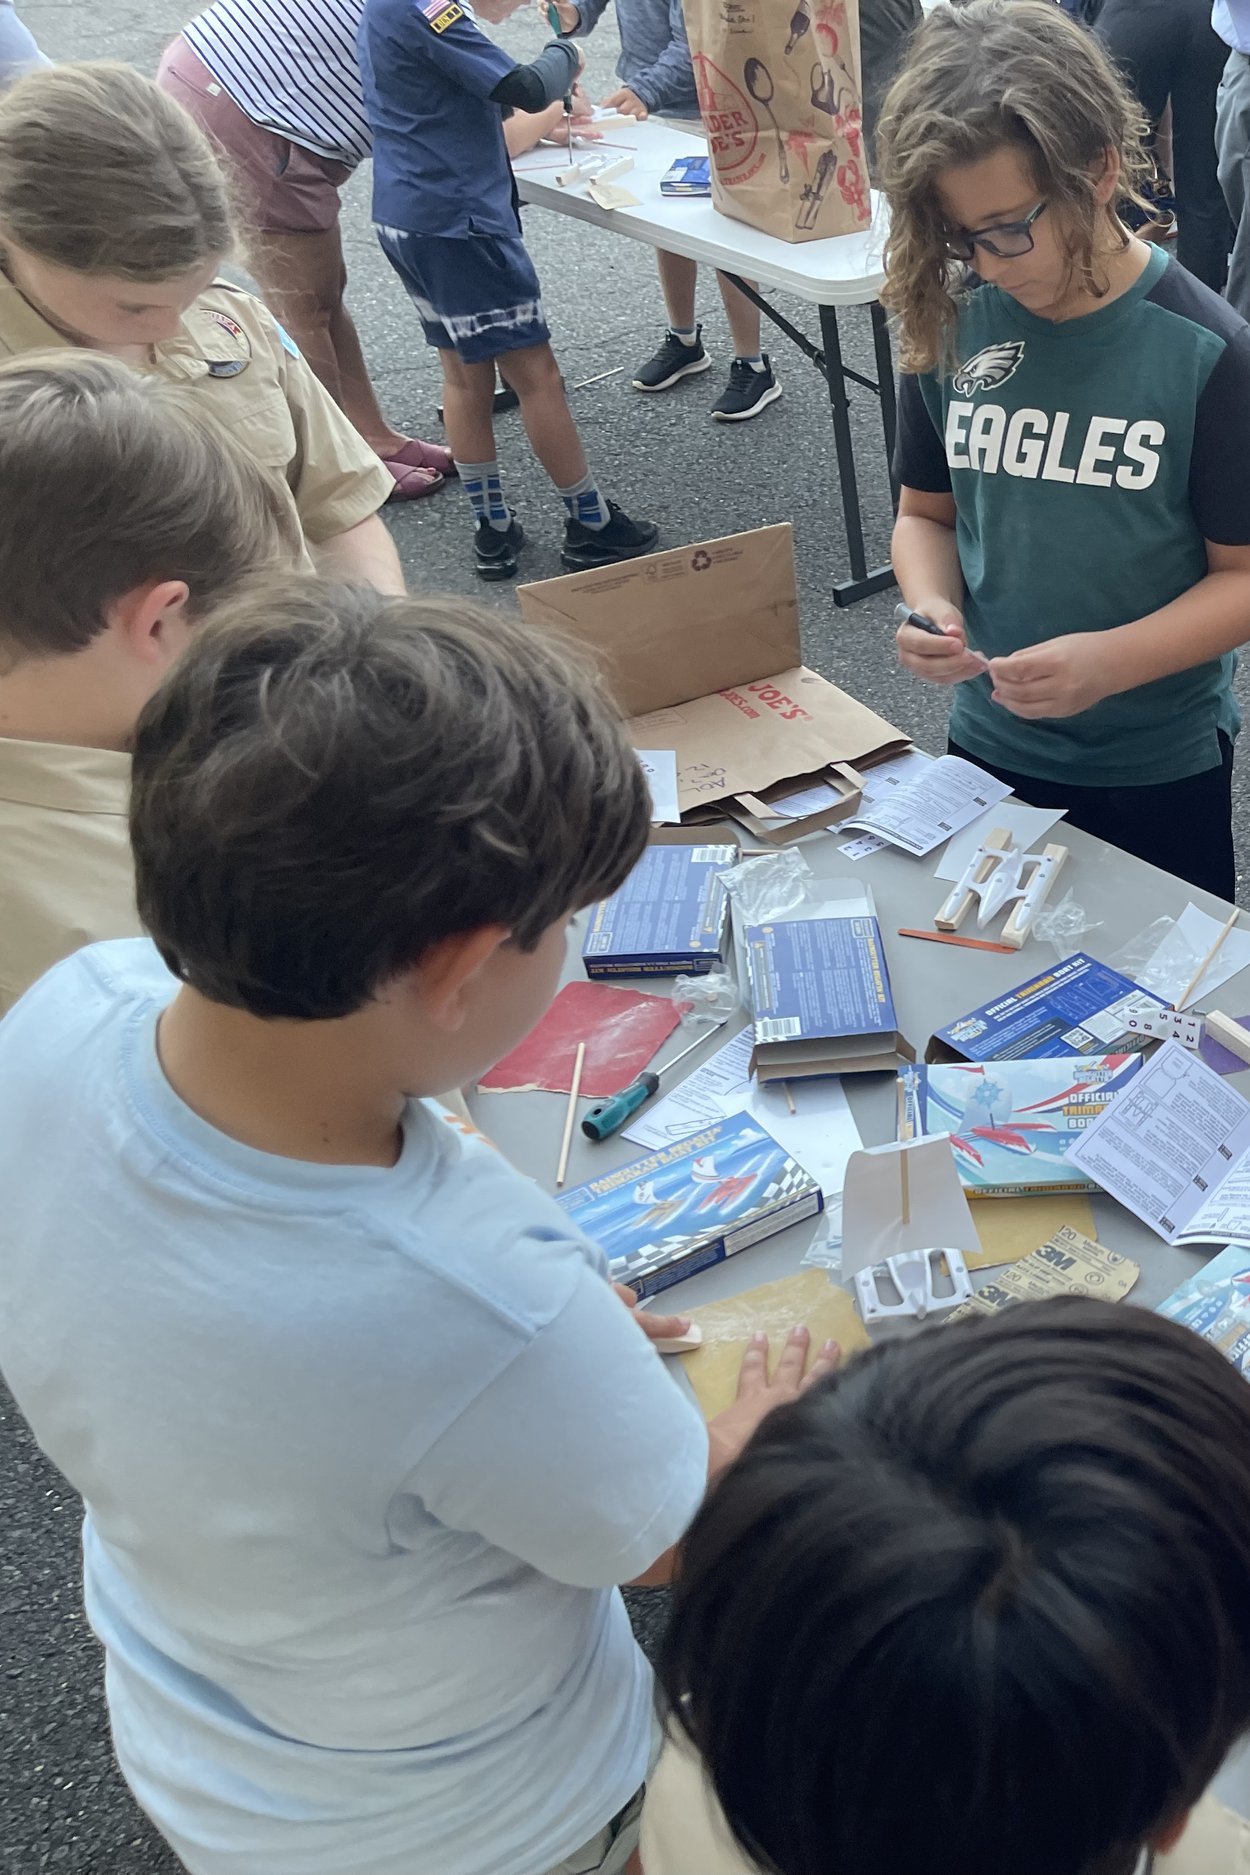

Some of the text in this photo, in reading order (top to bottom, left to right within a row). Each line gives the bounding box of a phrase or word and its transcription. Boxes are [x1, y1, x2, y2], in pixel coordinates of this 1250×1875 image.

[945, 400, 1166, 490] EAGLES
[985, 996, 1019, 1017] OFFICIAL
[1053, 964, 1074, 978] BOAT
[1072, 957, 1087, 968] KIT
[1058, 1224, 1078, 1242] 120
[1034, 1244, 1078, 1272] 3M
